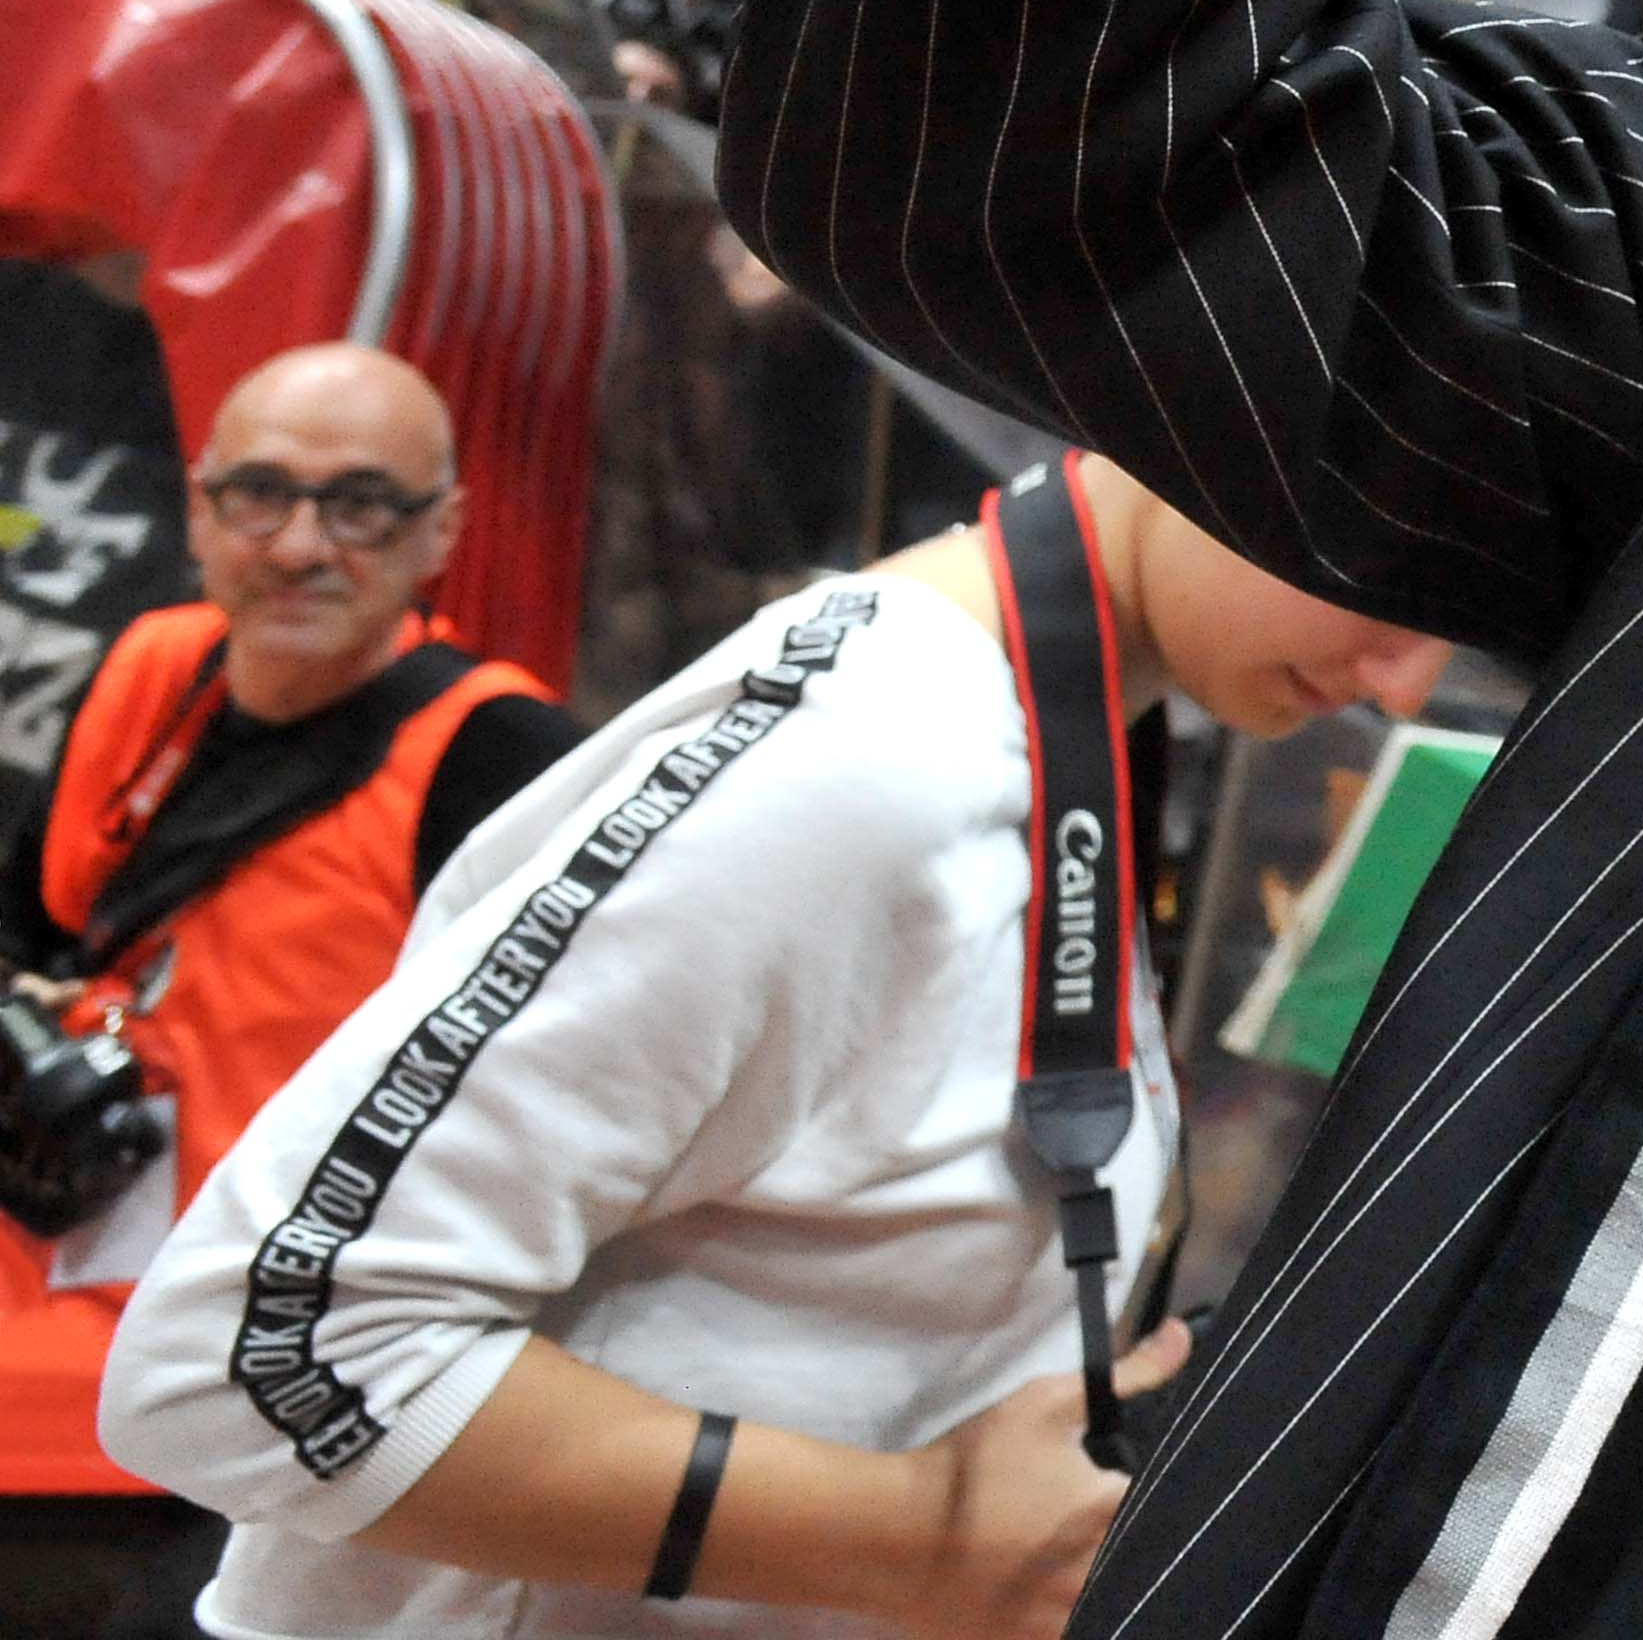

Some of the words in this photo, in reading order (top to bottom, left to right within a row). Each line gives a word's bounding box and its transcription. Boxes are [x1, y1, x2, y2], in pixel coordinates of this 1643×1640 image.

[352, 1040, 458, 1149] LOOK
[584, 778, 693, 870] LOOK
[1052, 807, 1103, 1017] Canon
